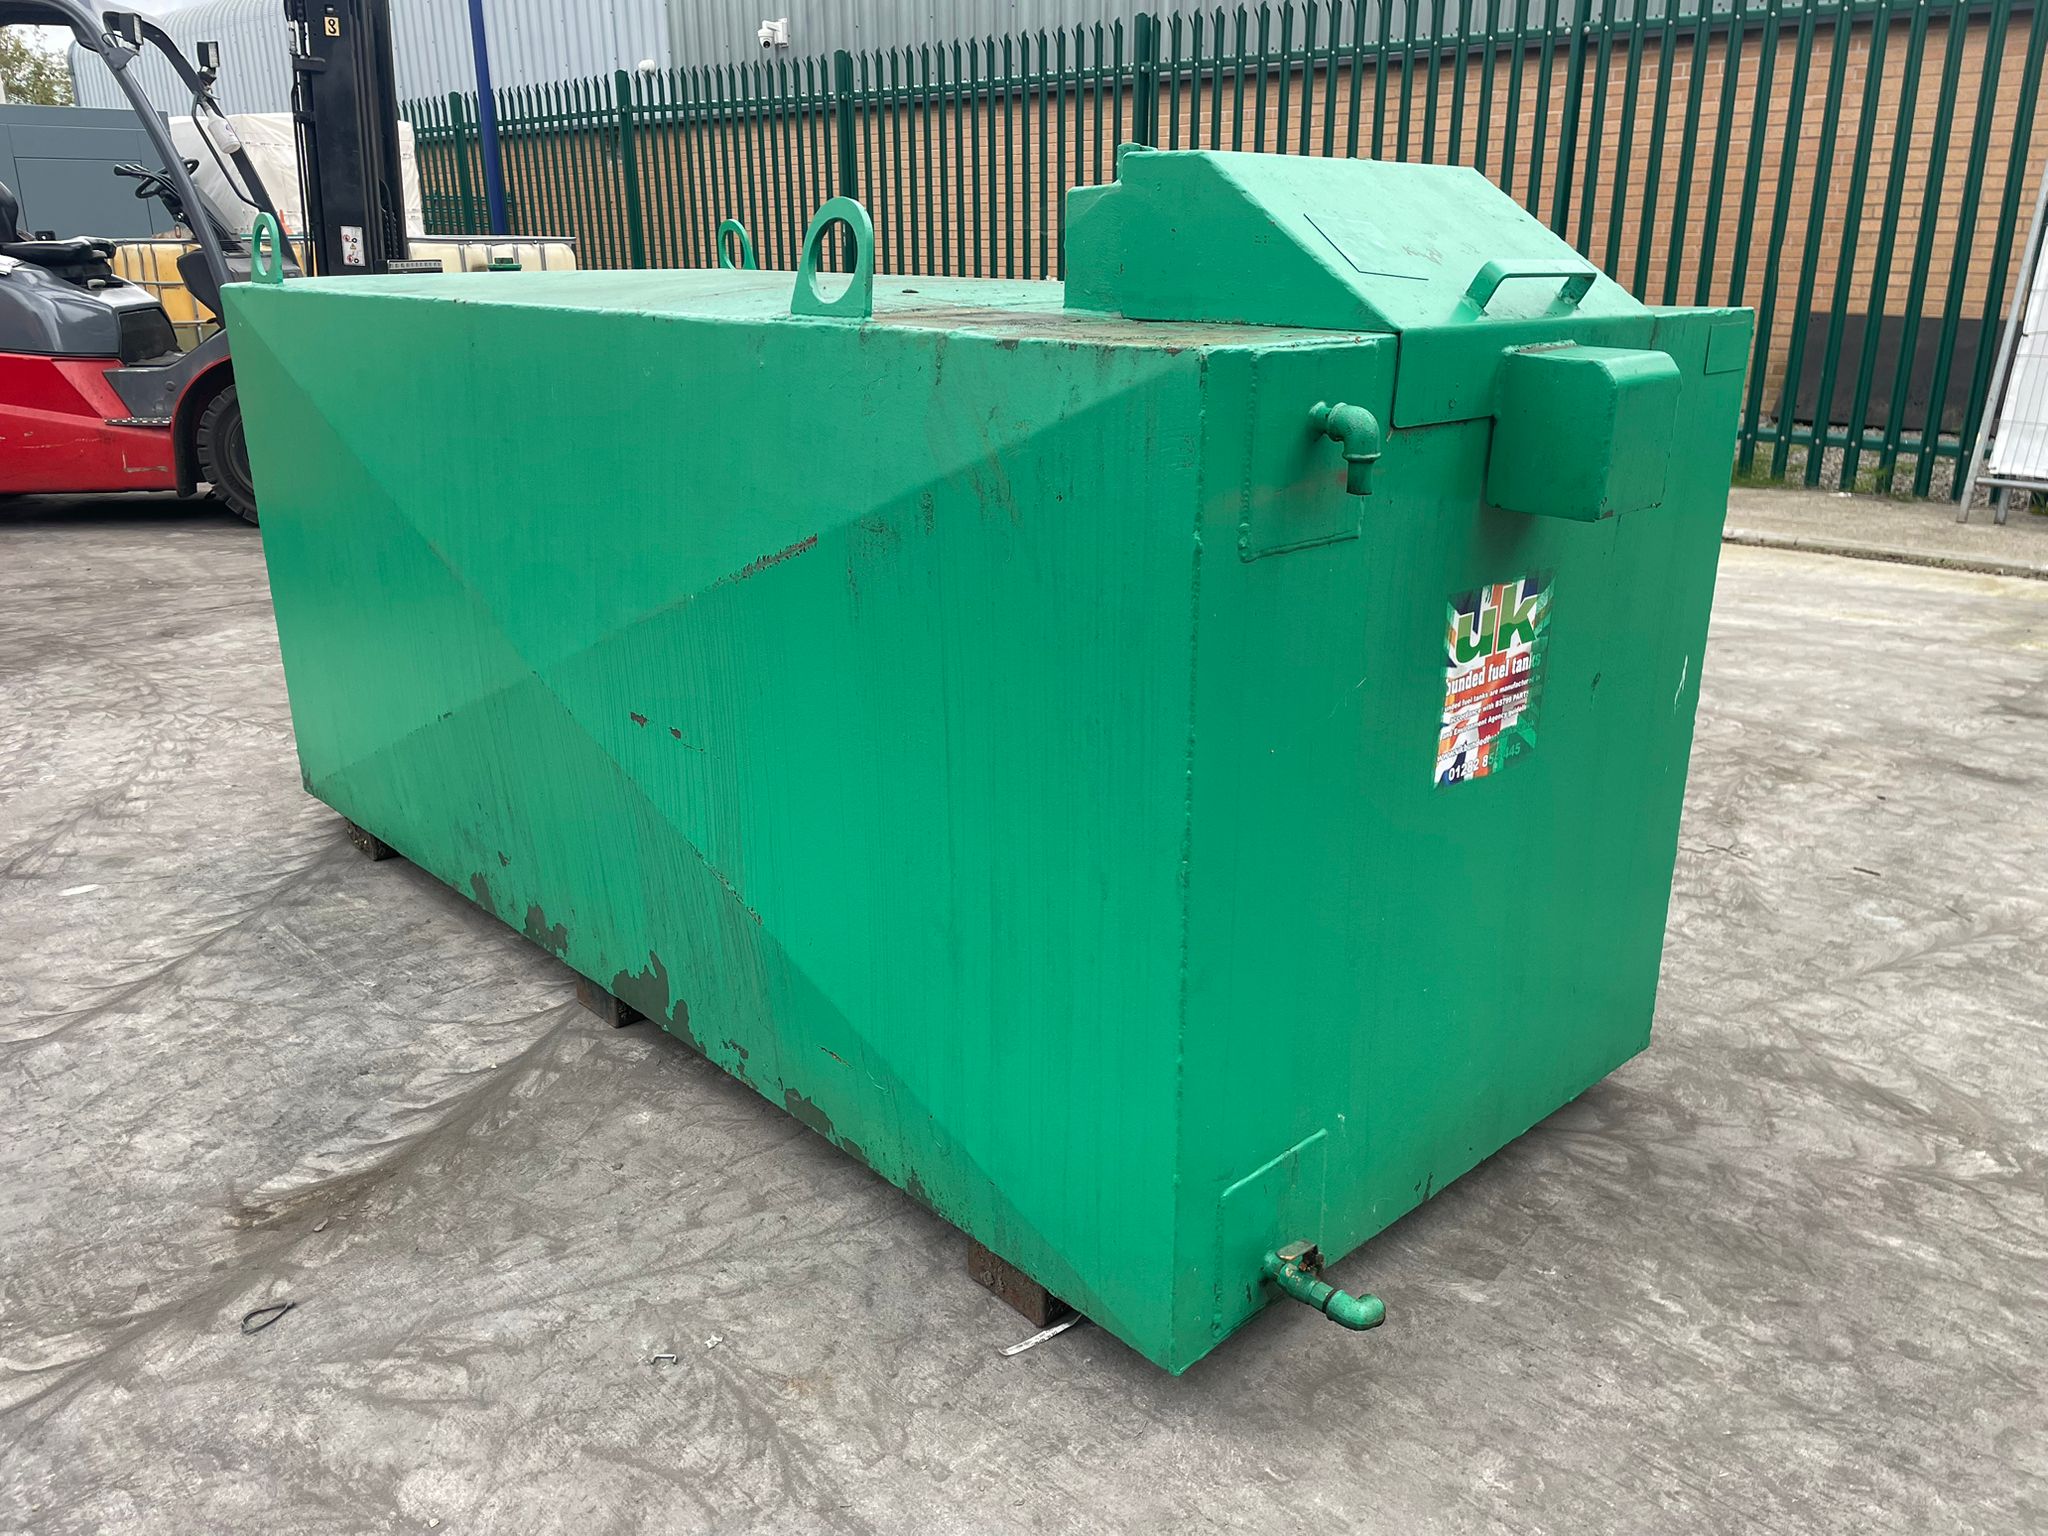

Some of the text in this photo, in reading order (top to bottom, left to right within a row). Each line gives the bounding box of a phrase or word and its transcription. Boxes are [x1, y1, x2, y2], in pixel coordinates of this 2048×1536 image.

[1455, 582, 1539, 664] uk
[1488, 657, 1509, 682] fuel
[1512, 652, 1541, 675] tanks
[1482, 701, 1494, 711] with
[1449, 758, 1479, 781] 01282
